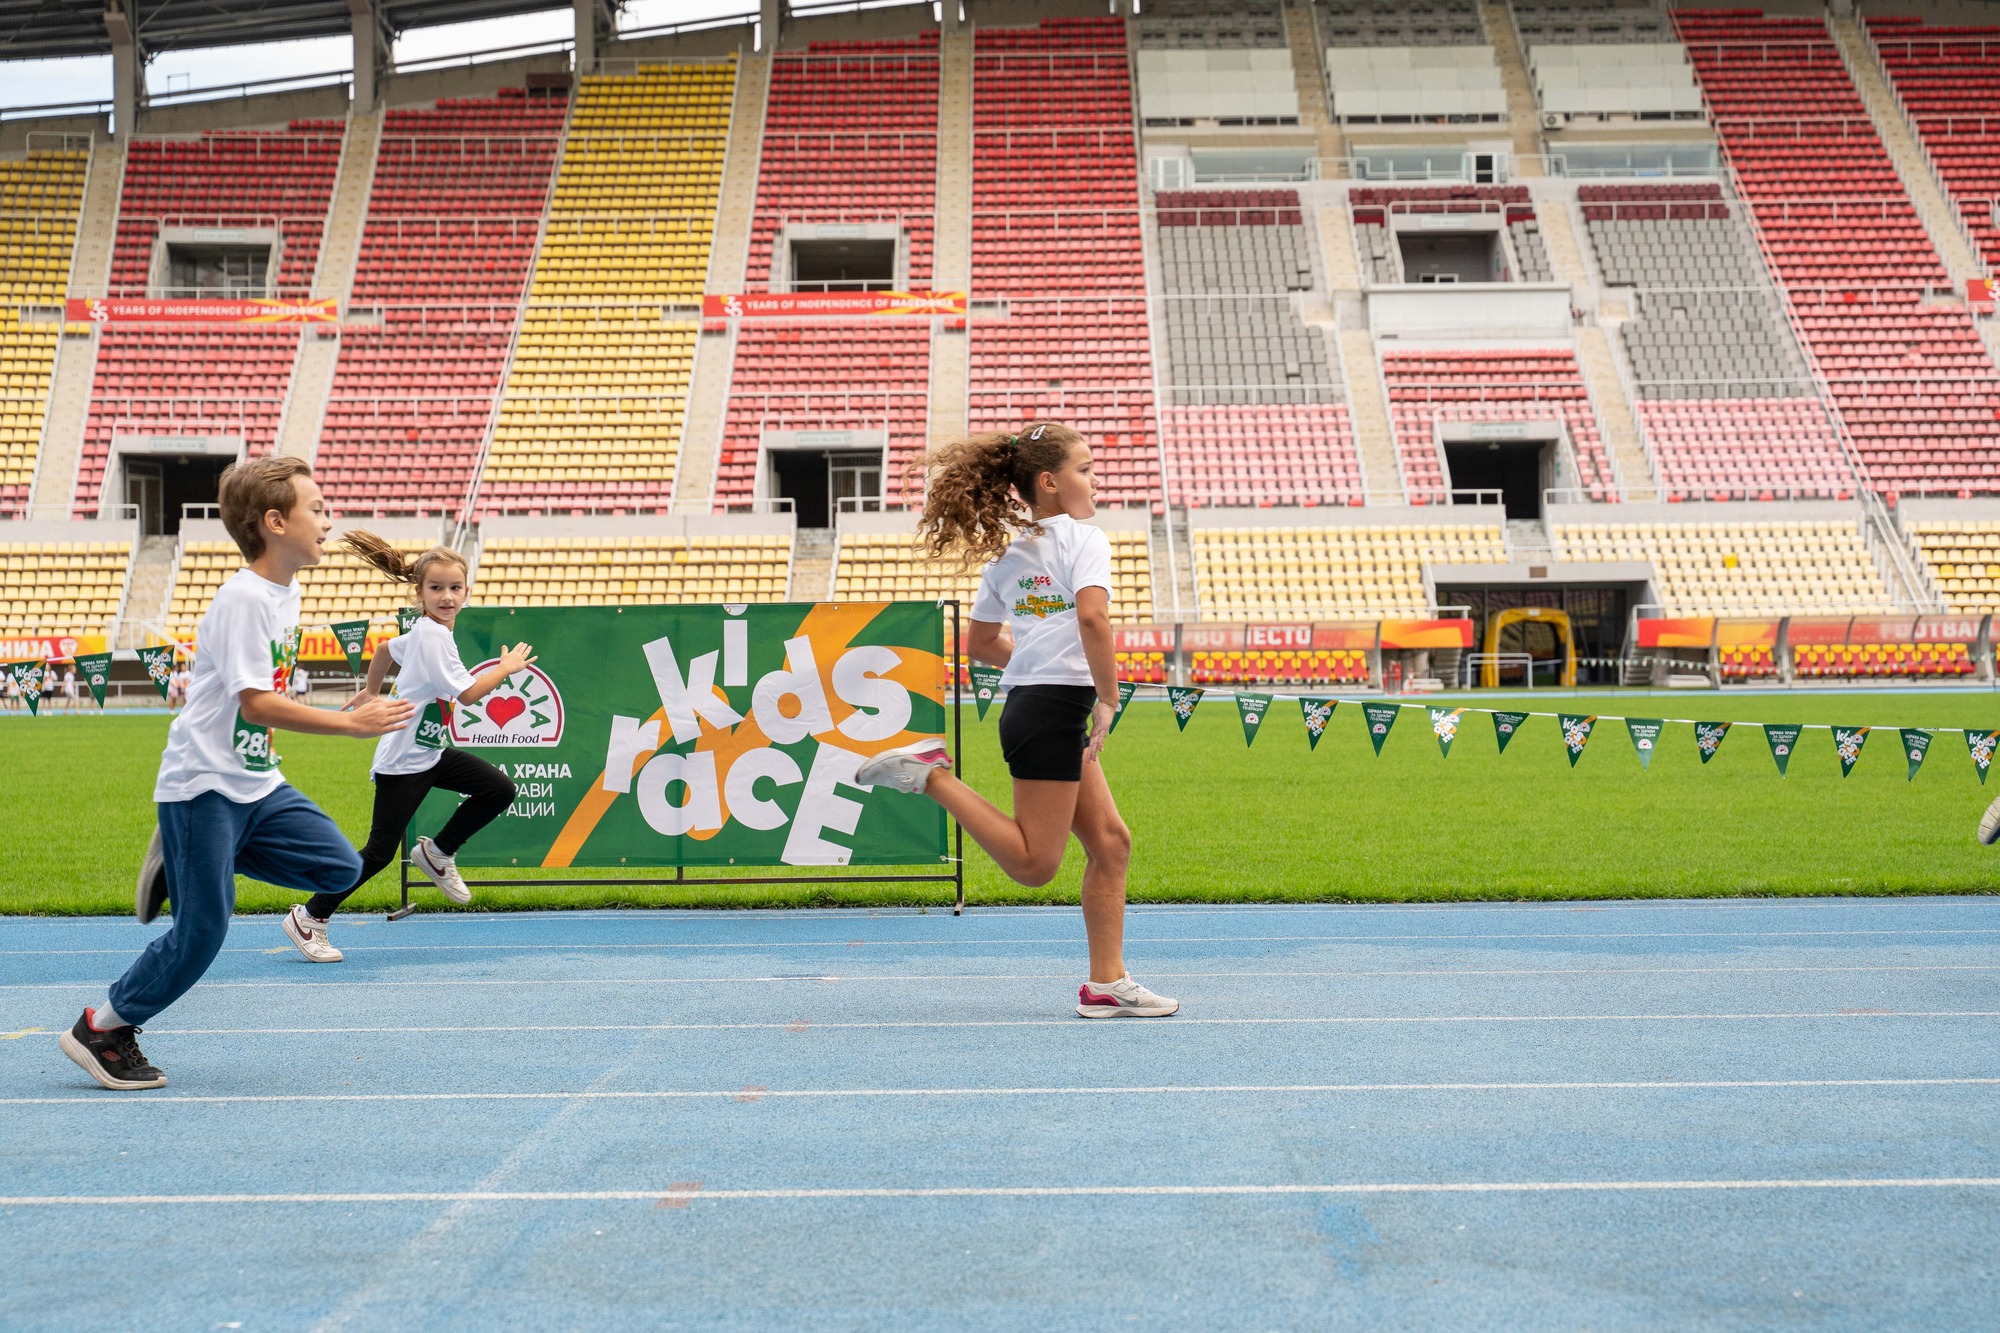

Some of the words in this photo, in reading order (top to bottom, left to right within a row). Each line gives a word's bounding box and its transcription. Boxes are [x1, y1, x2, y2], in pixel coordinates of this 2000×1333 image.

[746, 300, 779, 310] YEARS
[780, 300, 794, 310] OF
[797, 298, 872, 310] INDEPENDENCE
[874, 298, 889, 309] OF
[890, 298, 954, 308] MACEDONIA
[112, 305, 146, 316] YEARS
[148, 305, 161, 316] OF
[164, 305, 242, 316] INDEPENDENCE
[244, 306, 258, 316] OF
[260, 306, 326, 316] MACEDONIA
[1027, 596, 1048, 606] СТАРТ
[1051, 594, 1064, 603] ЗА
[1038, 602, 1074, 614] НАВИКИ
[1124, 630, 1156, 646] НА
[1161, 630, 1224, 646] ПВО
[642, 604, 912, 745] kids
[461, 674, 552, 728] VALIA
[472, 734, 508, 744] Health
[512, 734, 540, 744] Food
[514, 764, 572, 778] ХРАНА
